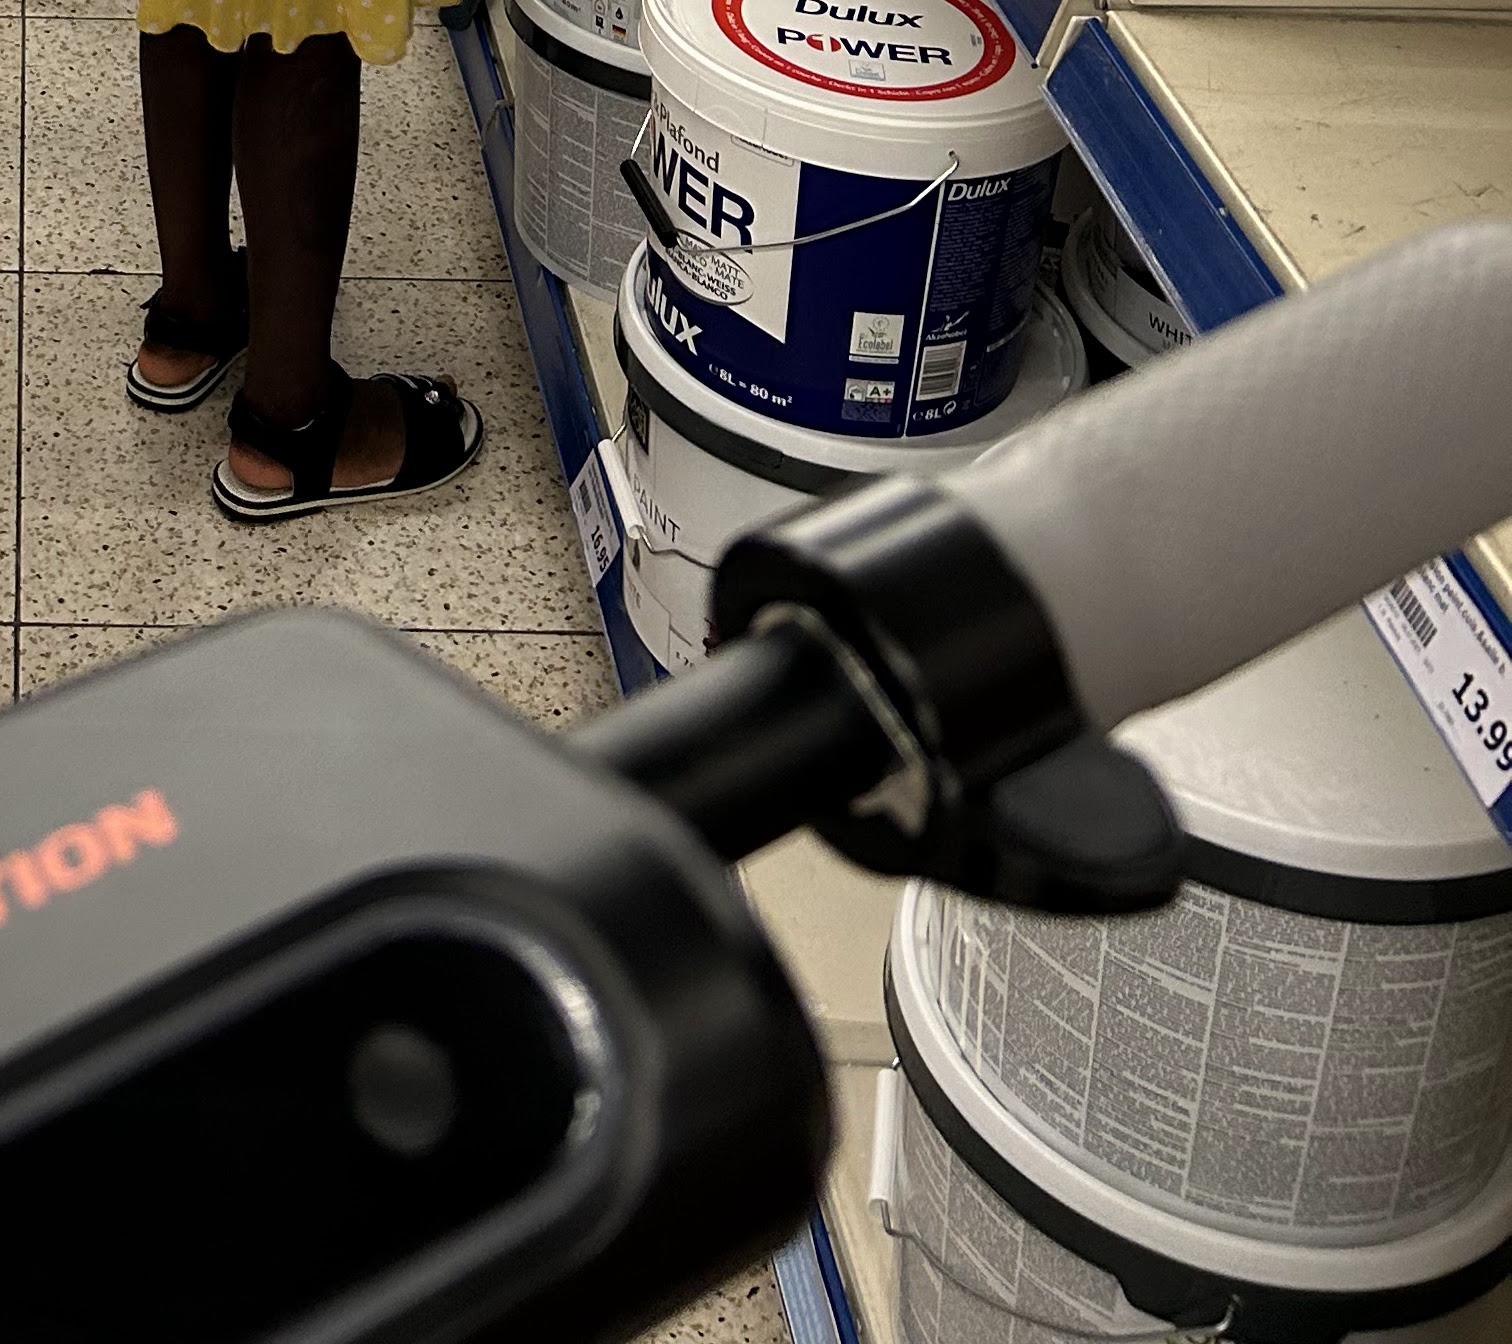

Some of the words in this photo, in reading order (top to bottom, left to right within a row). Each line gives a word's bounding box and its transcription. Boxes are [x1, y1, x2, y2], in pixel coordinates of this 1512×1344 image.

[776, 26, 953, 66] POWER
[660, 103, 720, 175] Plafond
[652, 131, 755, 256] WER
[948, 176, 1012, 202] Dulux
[711, 255, 740, 277] MATT
[715, 267, 745, 290] MATE
[648, 276, 703, 357] ulux
[1149, 312, 1194, 347] WHIT
[858, 332, 894, 352] Ecolabel
[719, 367, 736, 387] 8L
[749, 383, 769, 401] 80
[772, 394, 793, 408] m²
[869, 385, 892, 398] A+
[591, 524, 611, 573] 16.95
[1451, 672, 1512, 772] 13.99
